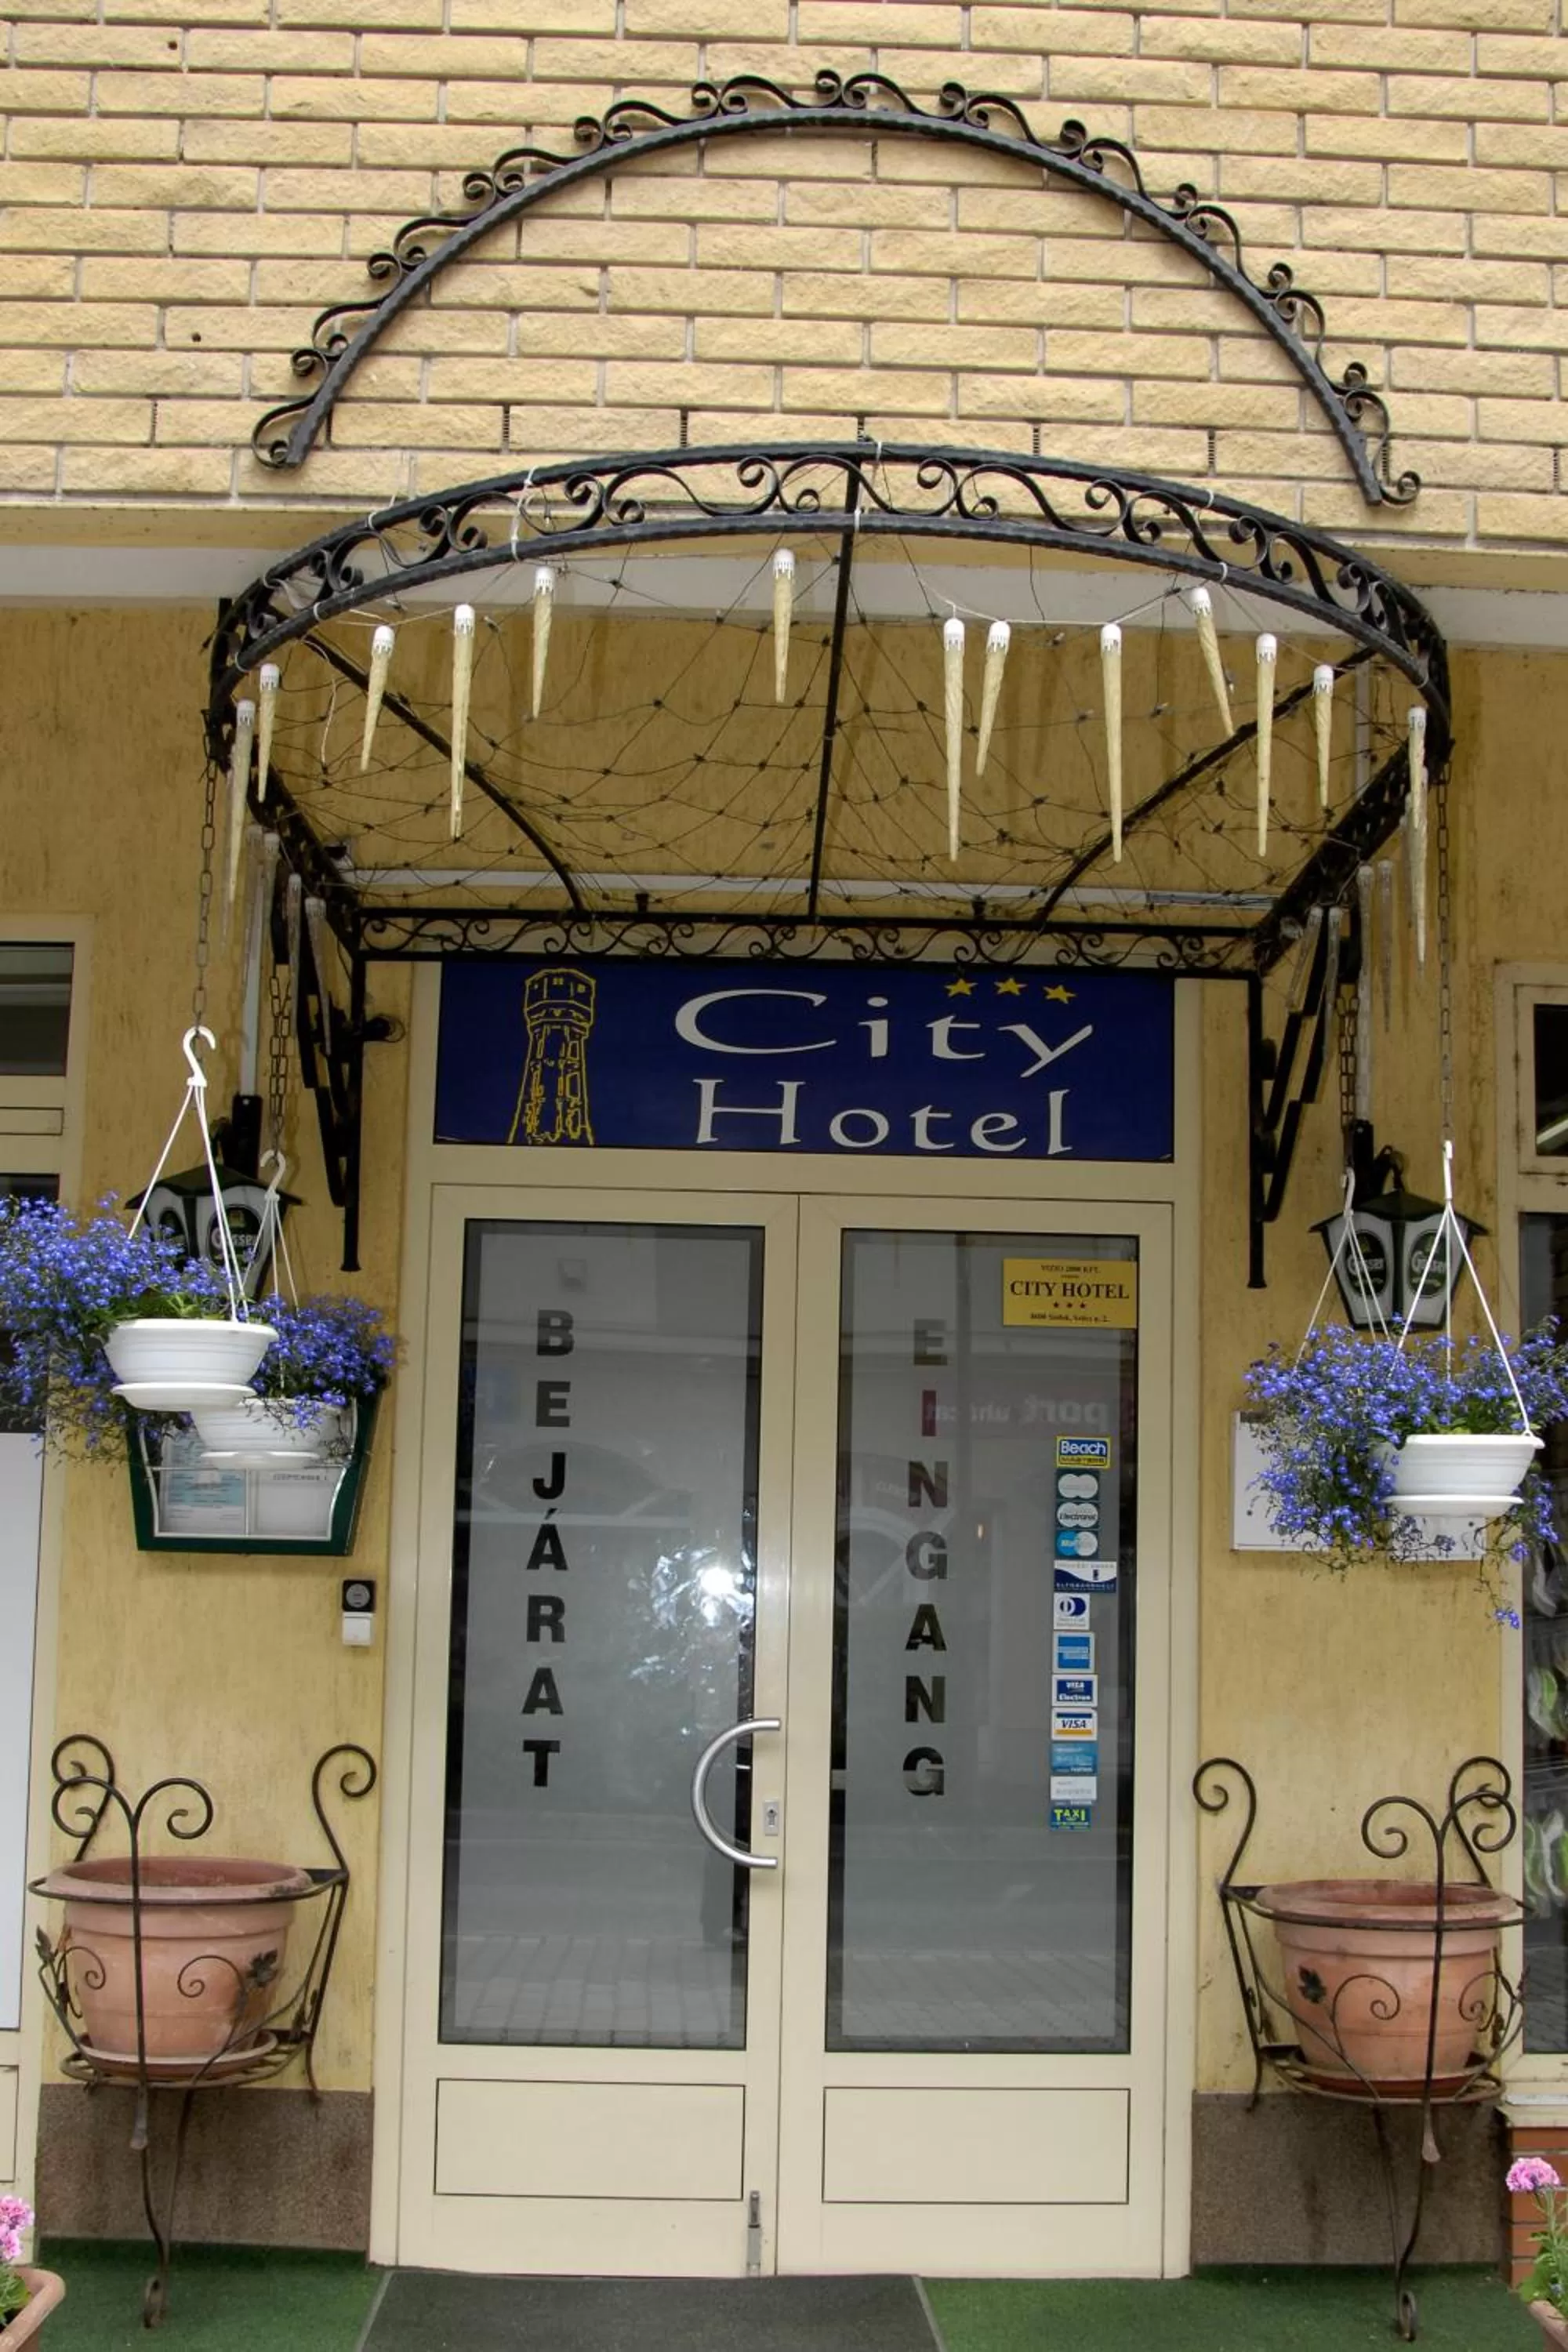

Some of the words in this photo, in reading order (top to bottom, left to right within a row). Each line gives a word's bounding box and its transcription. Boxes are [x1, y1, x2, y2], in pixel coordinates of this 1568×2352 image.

[675, 987, 1093, 1078] City
[693, 1078, 1073, 1156] Hotel
[1010, 1279, 1056, 1297] CITY
[1062, 1281, 1130, 1299] HOTEL
[1061, 1440, 1106, 1455] Beach
[902, 1319, 949, 1796] EINGANG
[1062, 1719, 1087, 1729] VISA
[1054, 1809, 1086, 1821] TAXI
